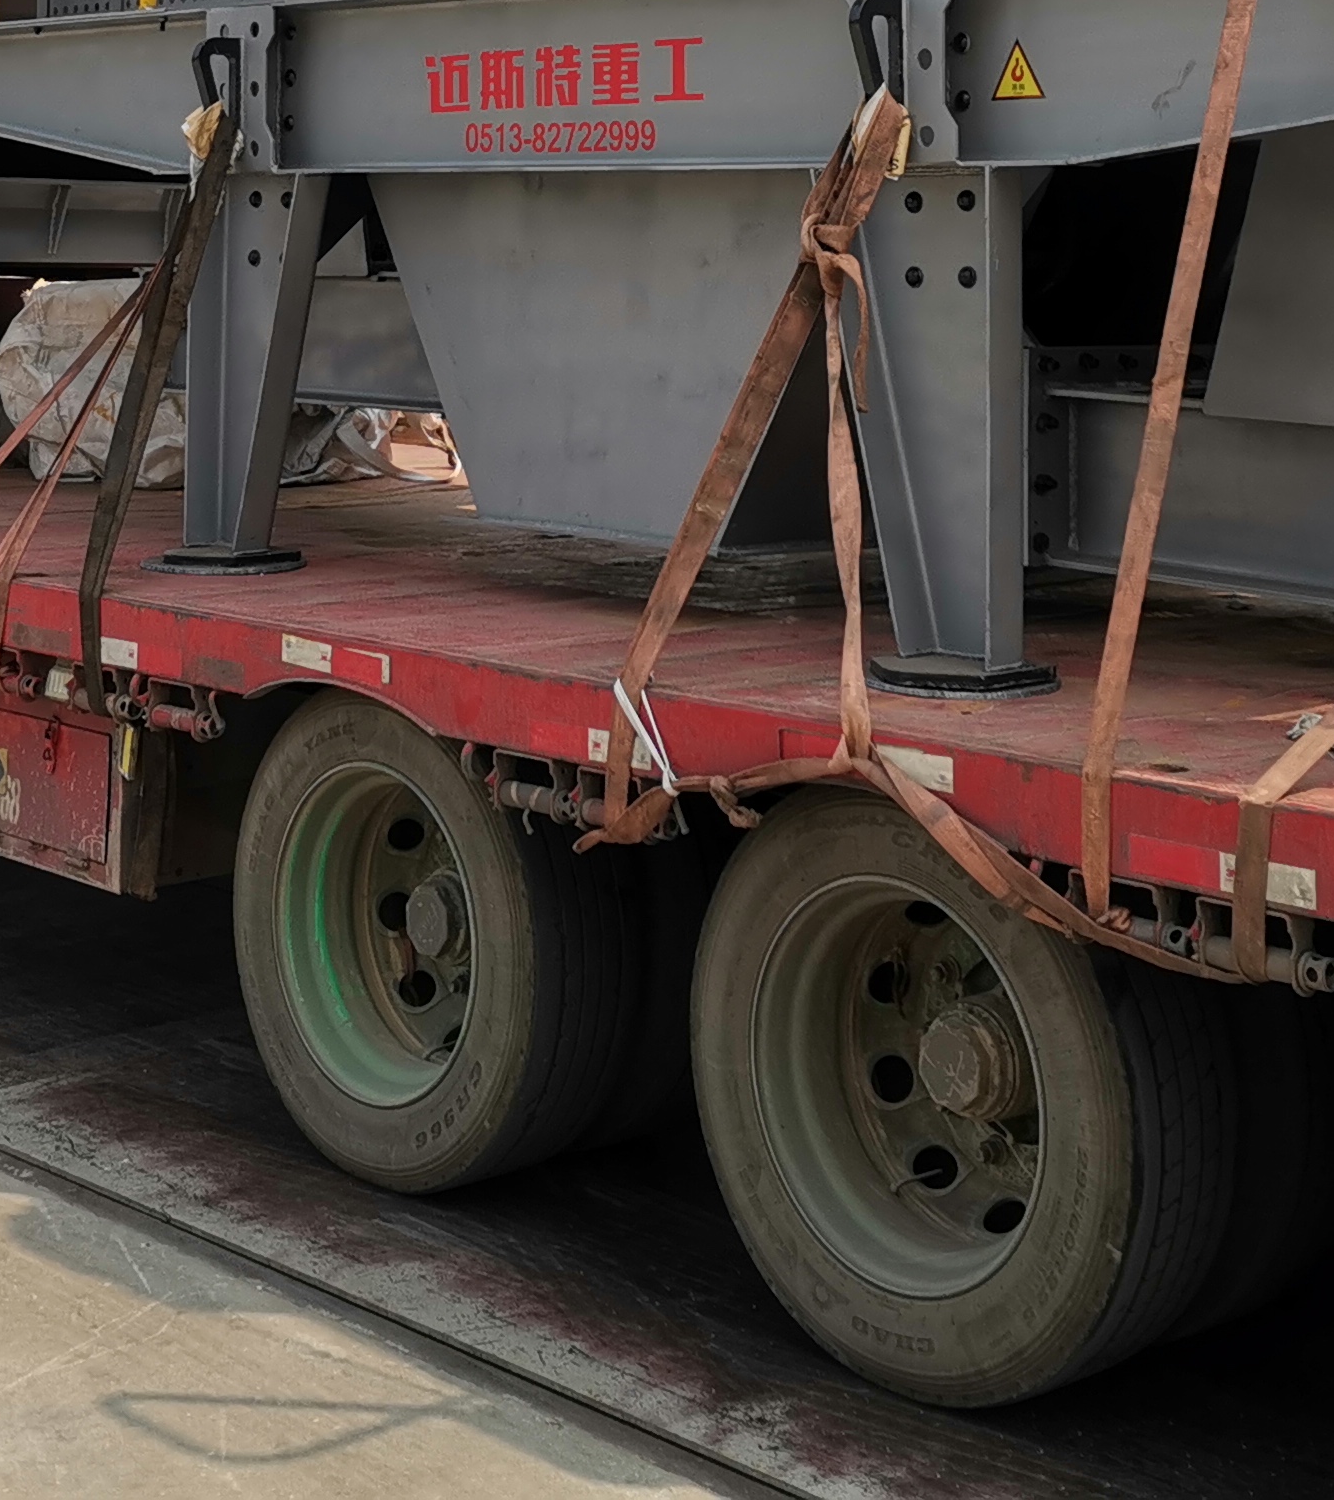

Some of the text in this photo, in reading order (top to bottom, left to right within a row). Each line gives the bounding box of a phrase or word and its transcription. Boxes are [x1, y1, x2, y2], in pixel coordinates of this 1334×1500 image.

[424, 36, 705, 113] 迈斯特重工
[465, 118, 657, 153] 0513-82722999
